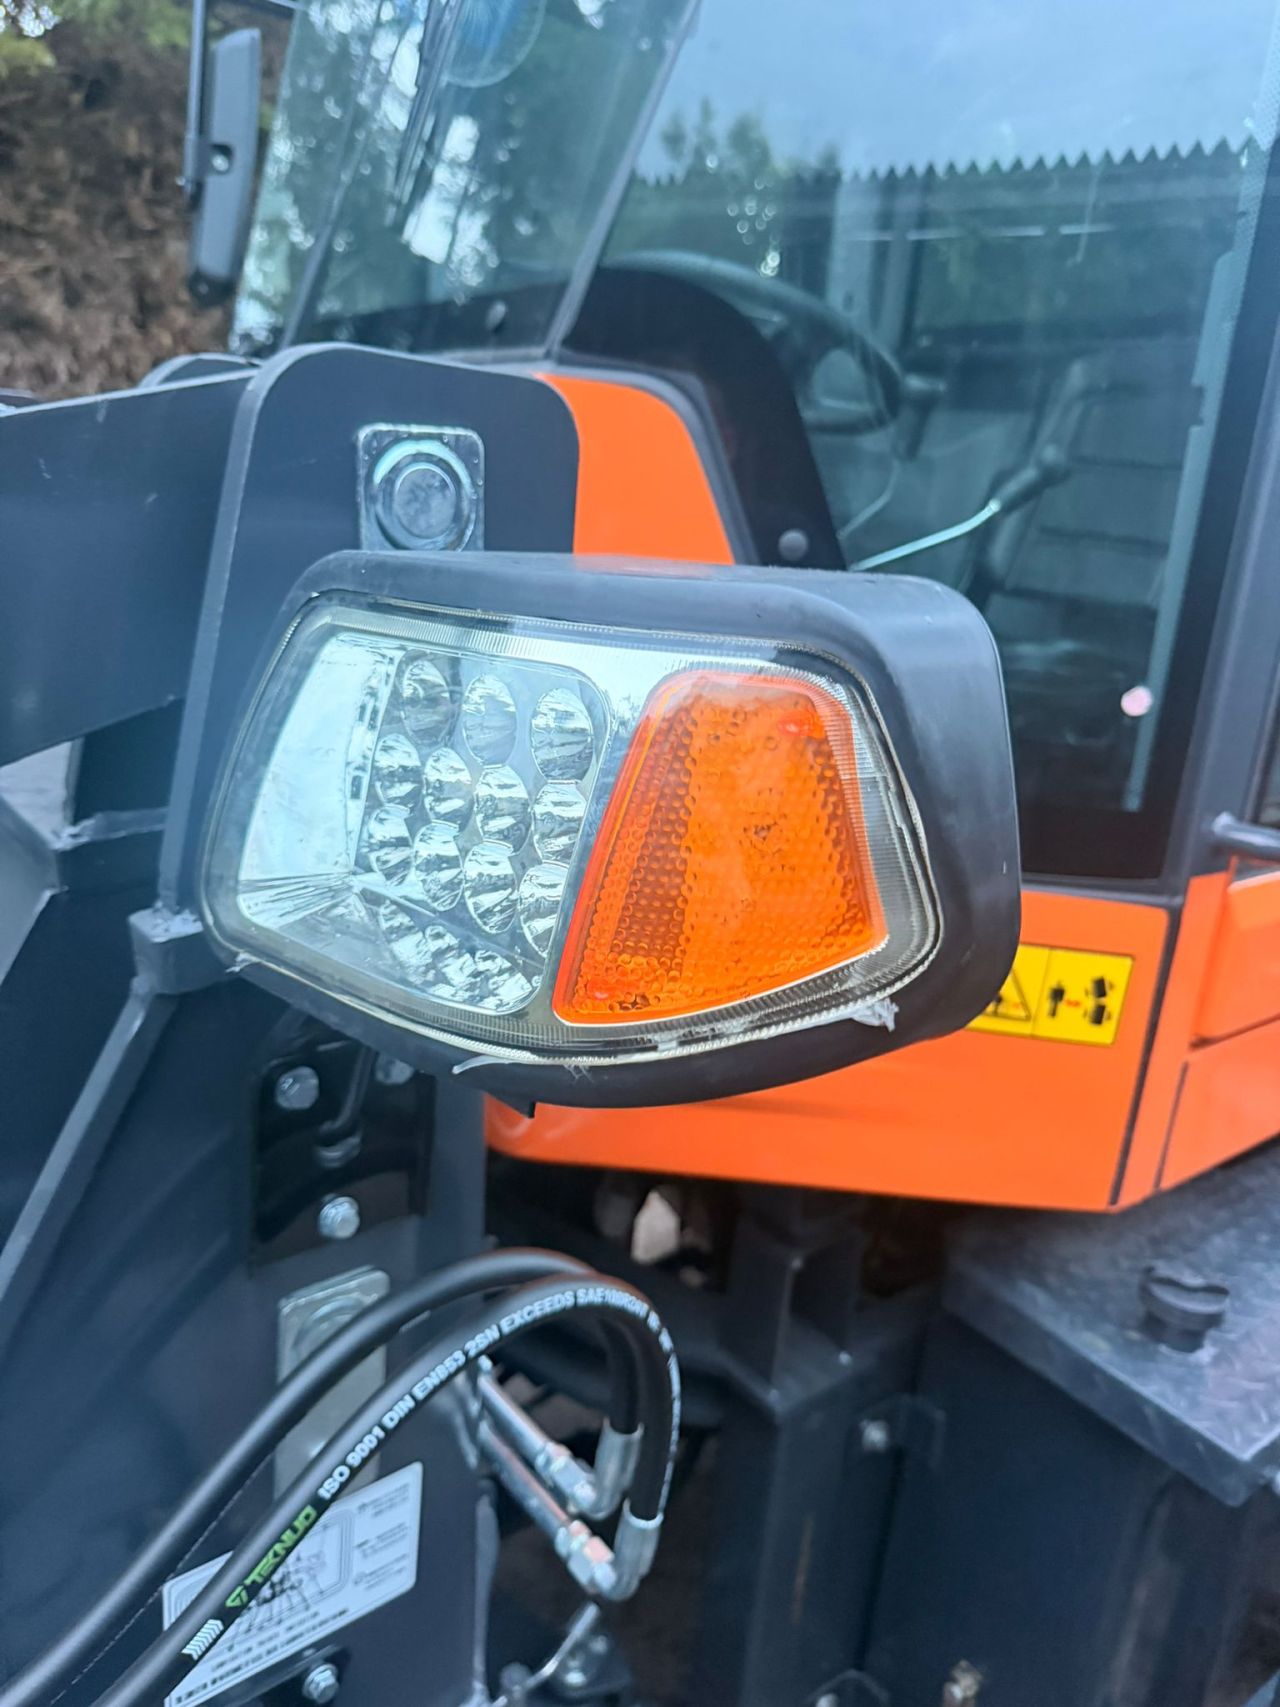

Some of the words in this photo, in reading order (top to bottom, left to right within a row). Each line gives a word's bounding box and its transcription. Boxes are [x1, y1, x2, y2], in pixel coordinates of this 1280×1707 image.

[317, 1465, 350, 1499] ISO
[346, 1425, 385, 1467] 9001
[381, 1394, 415, 1429] DIN
[411, 1349, 466, 1400] EN853
[463, 1324, 500, 1359] 2SN
[500, 1290, 575, 1335] EXCEEDS
